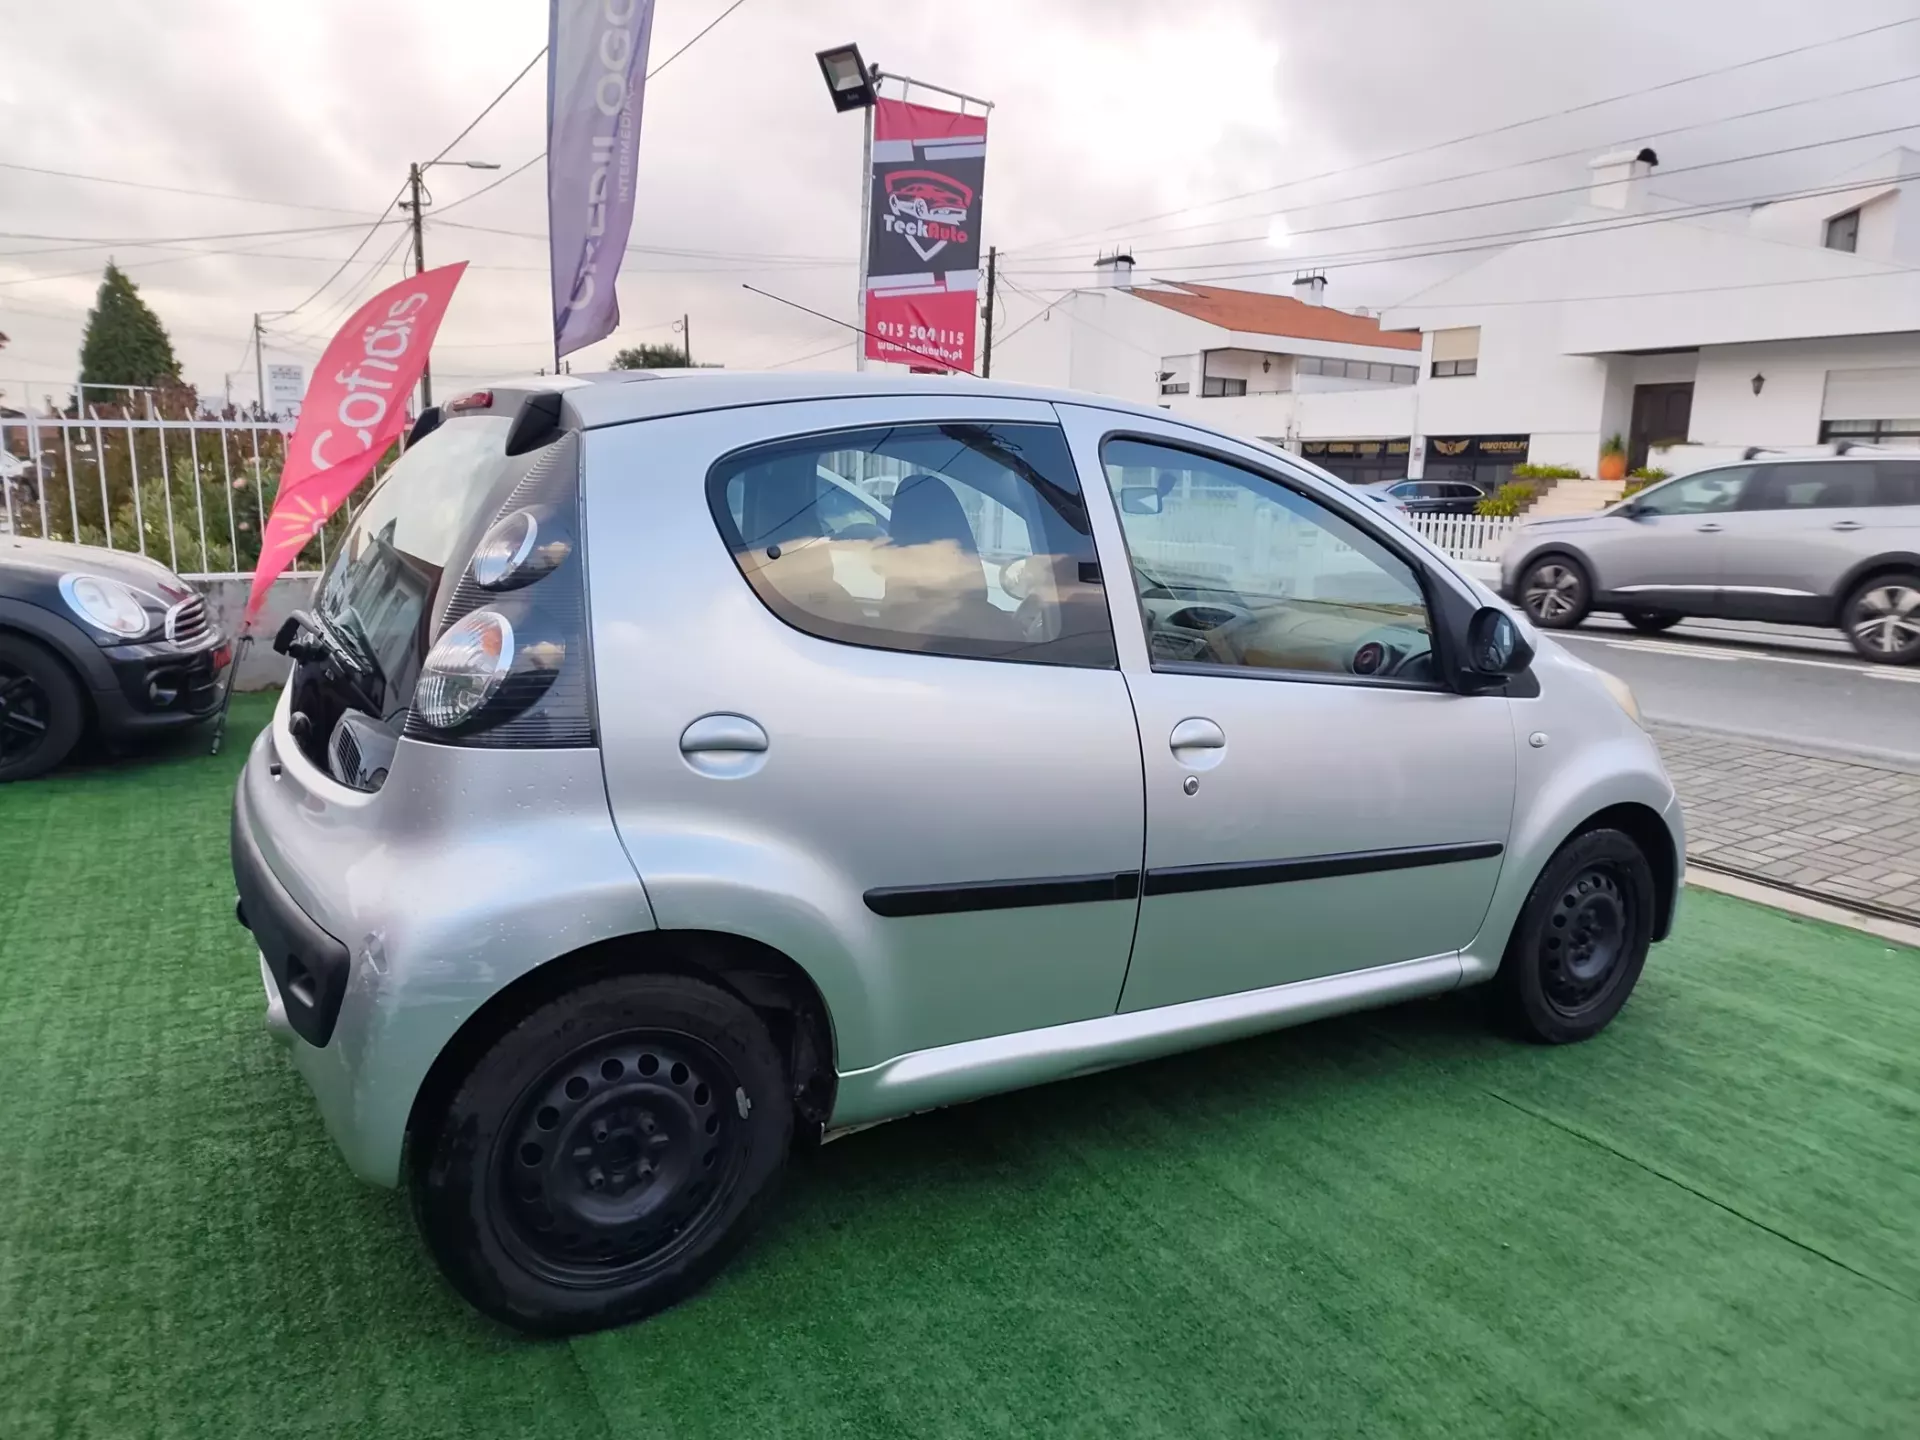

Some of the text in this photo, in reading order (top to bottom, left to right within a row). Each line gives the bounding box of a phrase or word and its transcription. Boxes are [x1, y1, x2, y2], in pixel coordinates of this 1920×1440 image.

[883, 213, 969, 243] TeckAuto
[877, 321, 965, 346] 913 504 115
[877, 341, 963, 361] www.teckauto.pt
[311, 292, 428, 471] Cofidis
